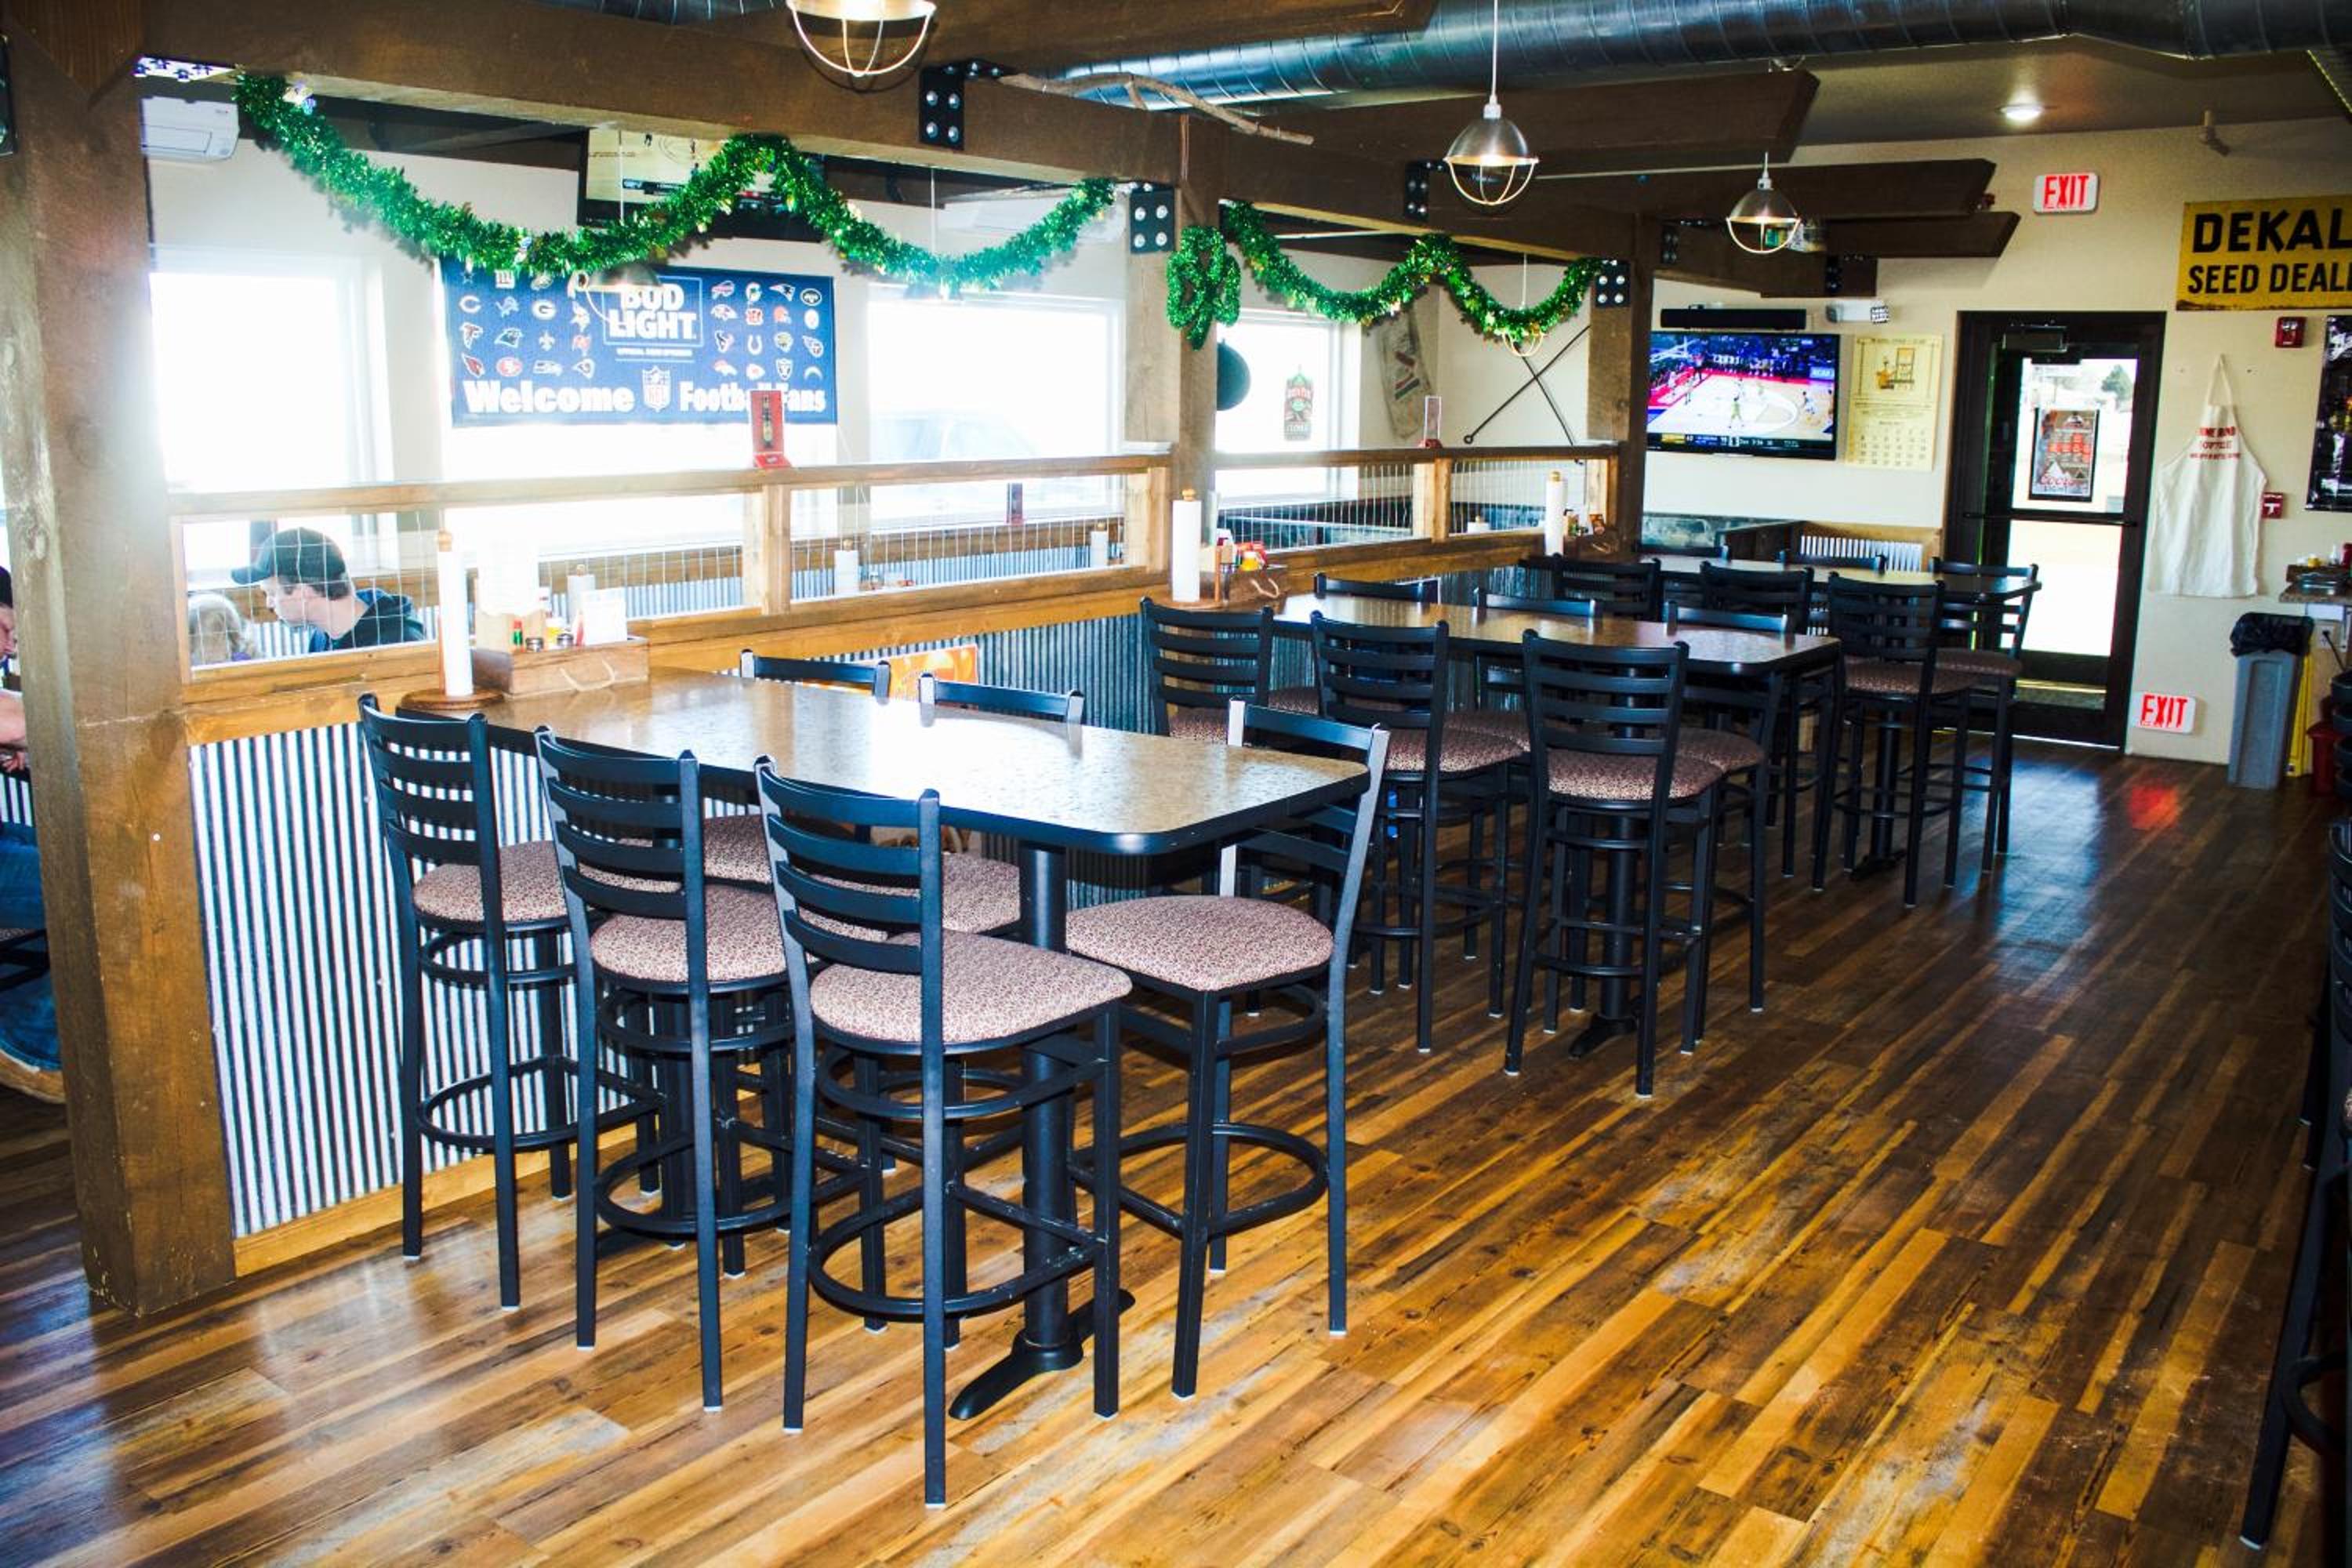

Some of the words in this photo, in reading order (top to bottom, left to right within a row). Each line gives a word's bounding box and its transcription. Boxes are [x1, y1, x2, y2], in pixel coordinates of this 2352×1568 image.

[2043, 174, 2089, 208] EXIT
[2187, 263, 2259, 295] SEED
[619, 283, 685, 311] BUD
[608, 309, 697, 339] LIGHT
[463, 379, 635, 413] Welcome
[2140, 694, 2188, 728] EXIT
